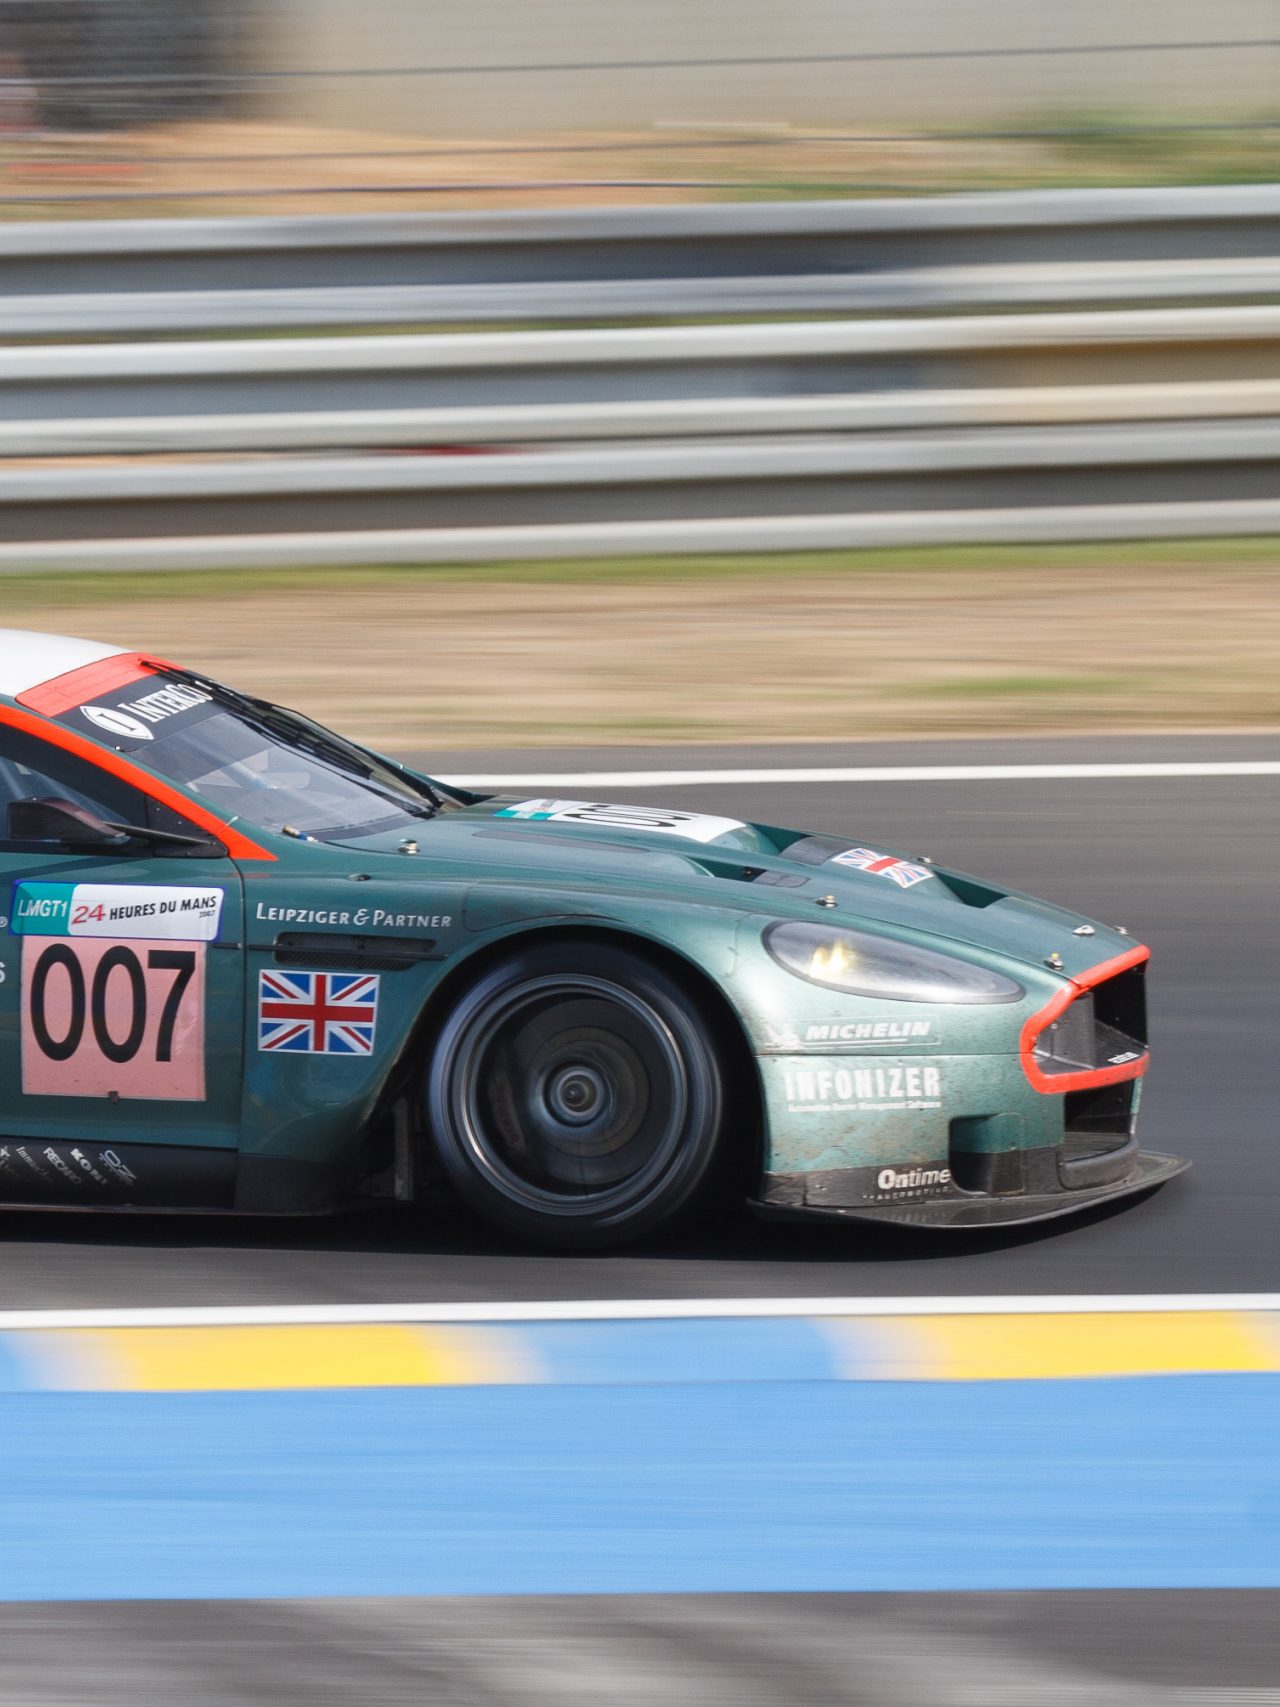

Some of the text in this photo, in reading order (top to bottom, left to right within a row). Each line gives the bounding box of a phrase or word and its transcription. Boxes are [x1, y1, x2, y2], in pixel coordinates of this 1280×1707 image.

[17, 896, 217, 925] LMGT1 24 HEURES DU MANS
[256, 902, 349, 924] LEIPZIGER
[372, 910, 452, 928] PARTNER
[30, 943, 197, 1063] 007
[805, 1021, 931, 1041] MICHELIN
[785, 1067, 941, 1101] INFONIZER
[43, 1147, 81, 1184] RECARO
[877, 1167, 952, 1190] Ontime
